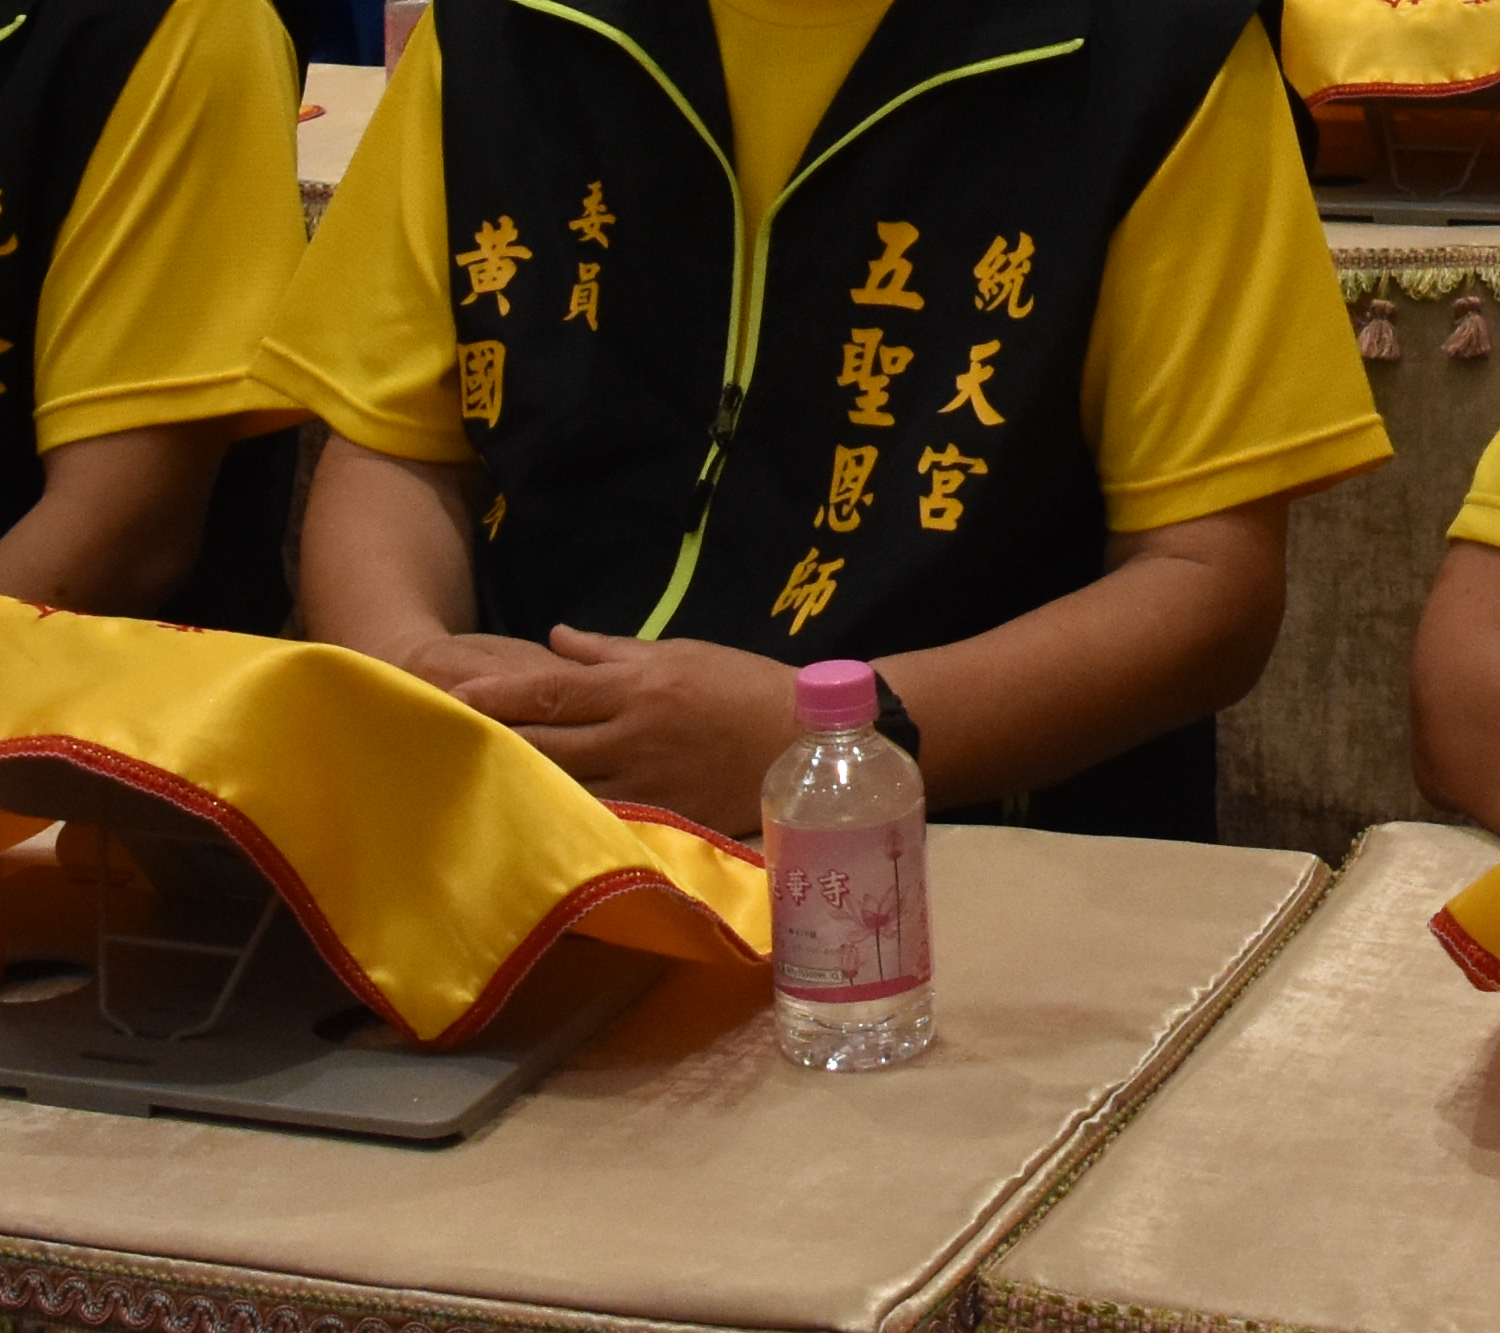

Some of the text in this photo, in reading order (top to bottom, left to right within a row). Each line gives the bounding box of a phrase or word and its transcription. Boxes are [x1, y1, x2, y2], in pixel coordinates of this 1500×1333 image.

[562, 180, 616, 331] 委員
[918, 231, 1036, 532] 統天宮
[770, 219, 926, 638] 五聖恩師
